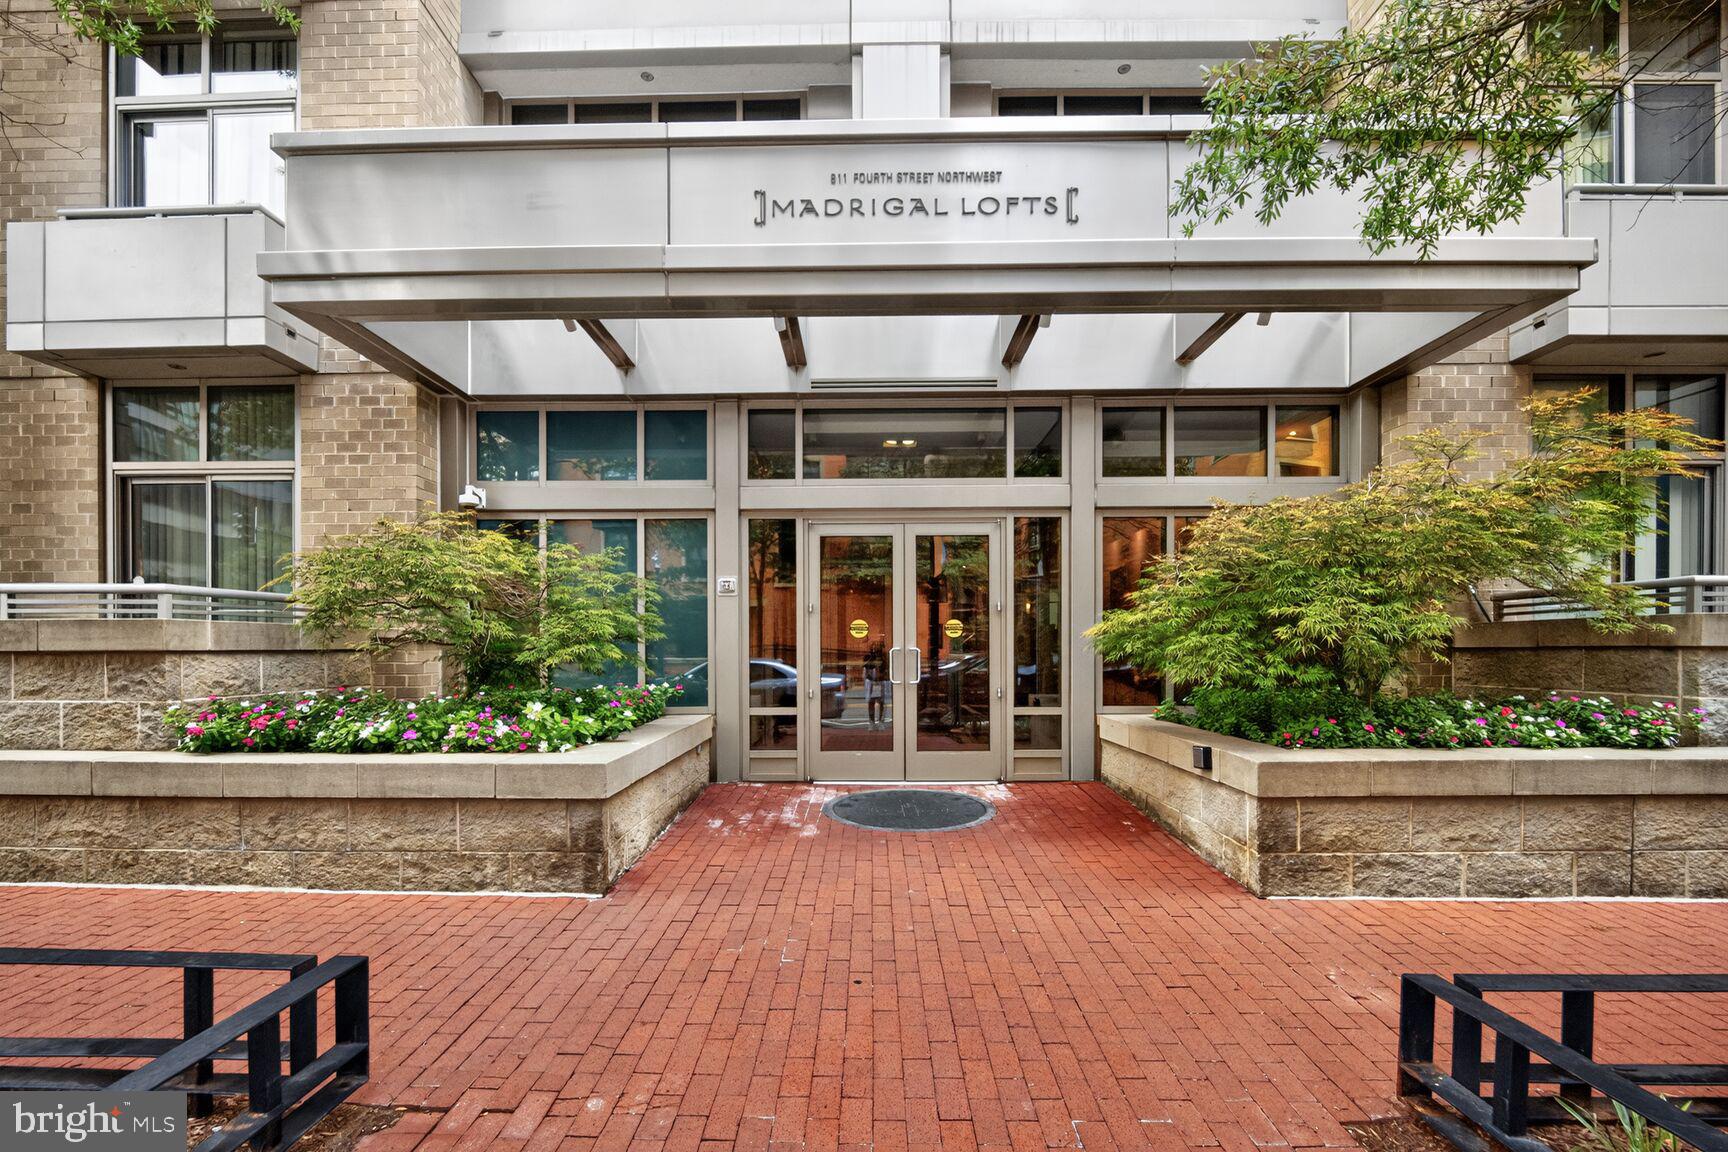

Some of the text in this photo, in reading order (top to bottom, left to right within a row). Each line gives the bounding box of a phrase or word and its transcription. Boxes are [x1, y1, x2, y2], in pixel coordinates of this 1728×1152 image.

[830, 170, 1003, 186] 811 FOURTH STREET NORTHWEST
[771, 196, 1059, 219] MADRIGAL LOFTS
